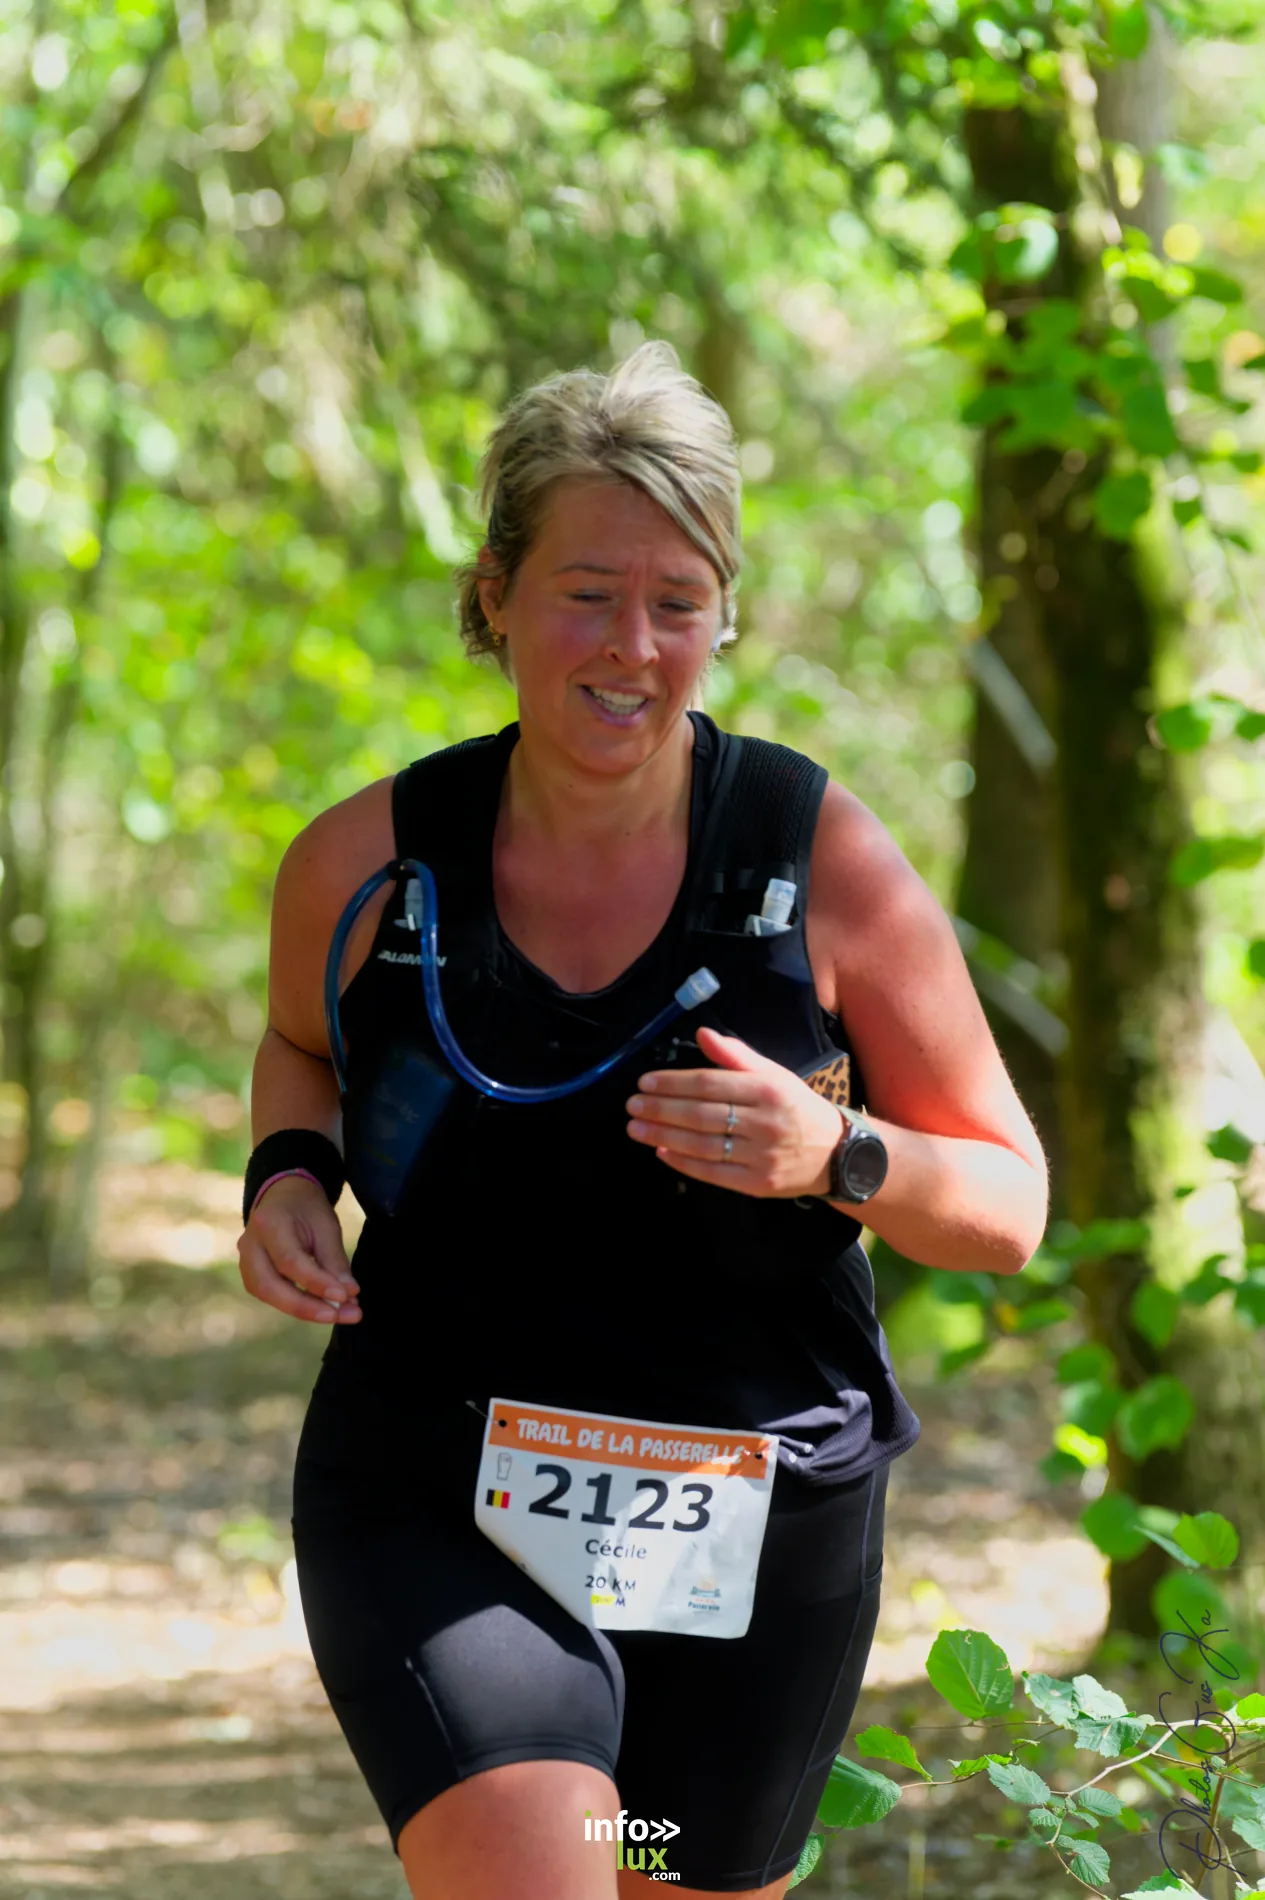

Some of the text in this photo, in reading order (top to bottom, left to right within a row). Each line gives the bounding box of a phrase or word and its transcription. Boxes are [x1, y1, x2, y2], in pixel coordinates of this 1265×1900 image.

[377, 950, 448, 967] ALOMN
[517, 1418, 746, 1465] TRAIL DE LA PASSERELLE
[528, 1463, 714, 1533] 2123
[585, 1539, 647, 1559] Cécile
[585, 1575, 636, 1592] 20 KM
